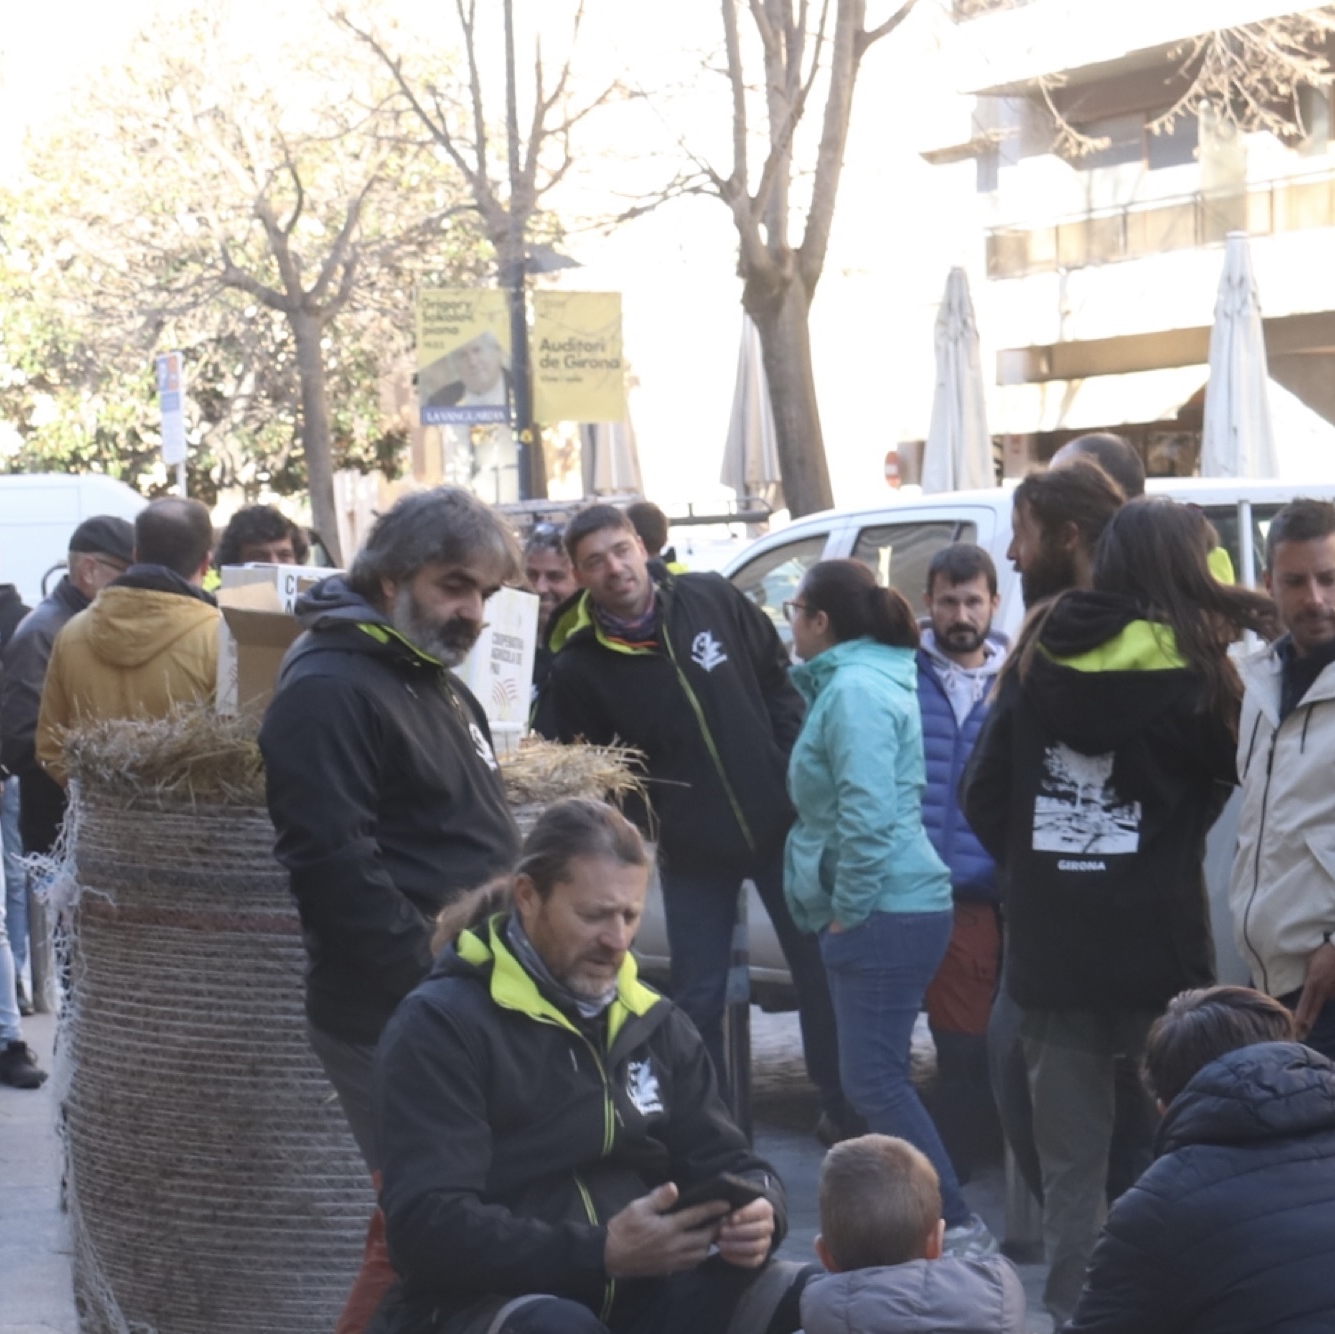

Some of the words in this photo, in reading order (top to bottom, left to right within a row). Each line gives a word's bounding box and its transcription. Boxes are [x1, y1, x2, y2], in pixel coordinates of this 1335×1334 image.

[539, 338, 606, 353] Auditori
[539, 355, 560, 370] de
[1057, 860, 1106, 871] GIRONA
